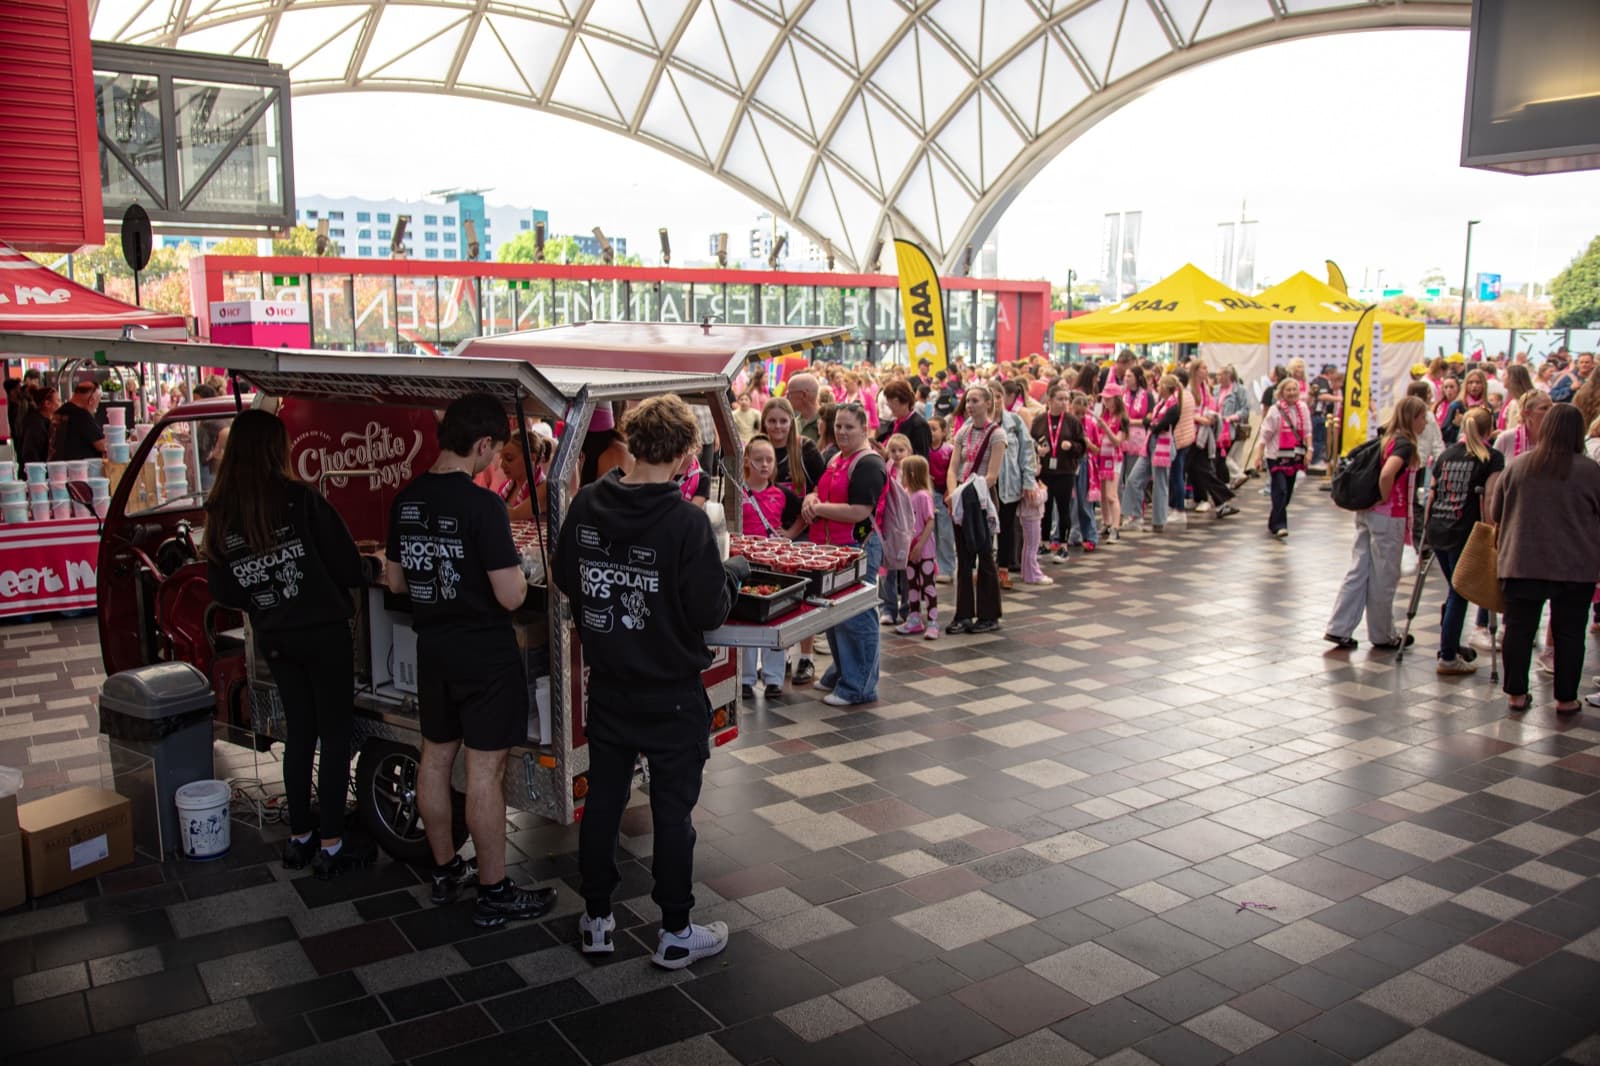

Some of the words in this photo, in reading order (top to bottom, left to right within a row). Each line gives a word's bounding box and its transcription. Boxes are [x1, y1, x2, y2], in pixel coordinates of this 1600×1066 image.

[277, 307, 296, 317] HCF
[910, 279, 936, 338] RAA
[1128, 299, 1179, 312] RAA
[1350, 345, 1366, 408] RAA
[297, 421, 406, 484] Chocolate
[233, 543, 306, 578] CHOCOLATE
[400, 541, 465, 559] CHOCATE
[0, 566, 64, 598] eat
[238, 569, 270, 588] BOYS
[581, 579, 612, 599] OYS
